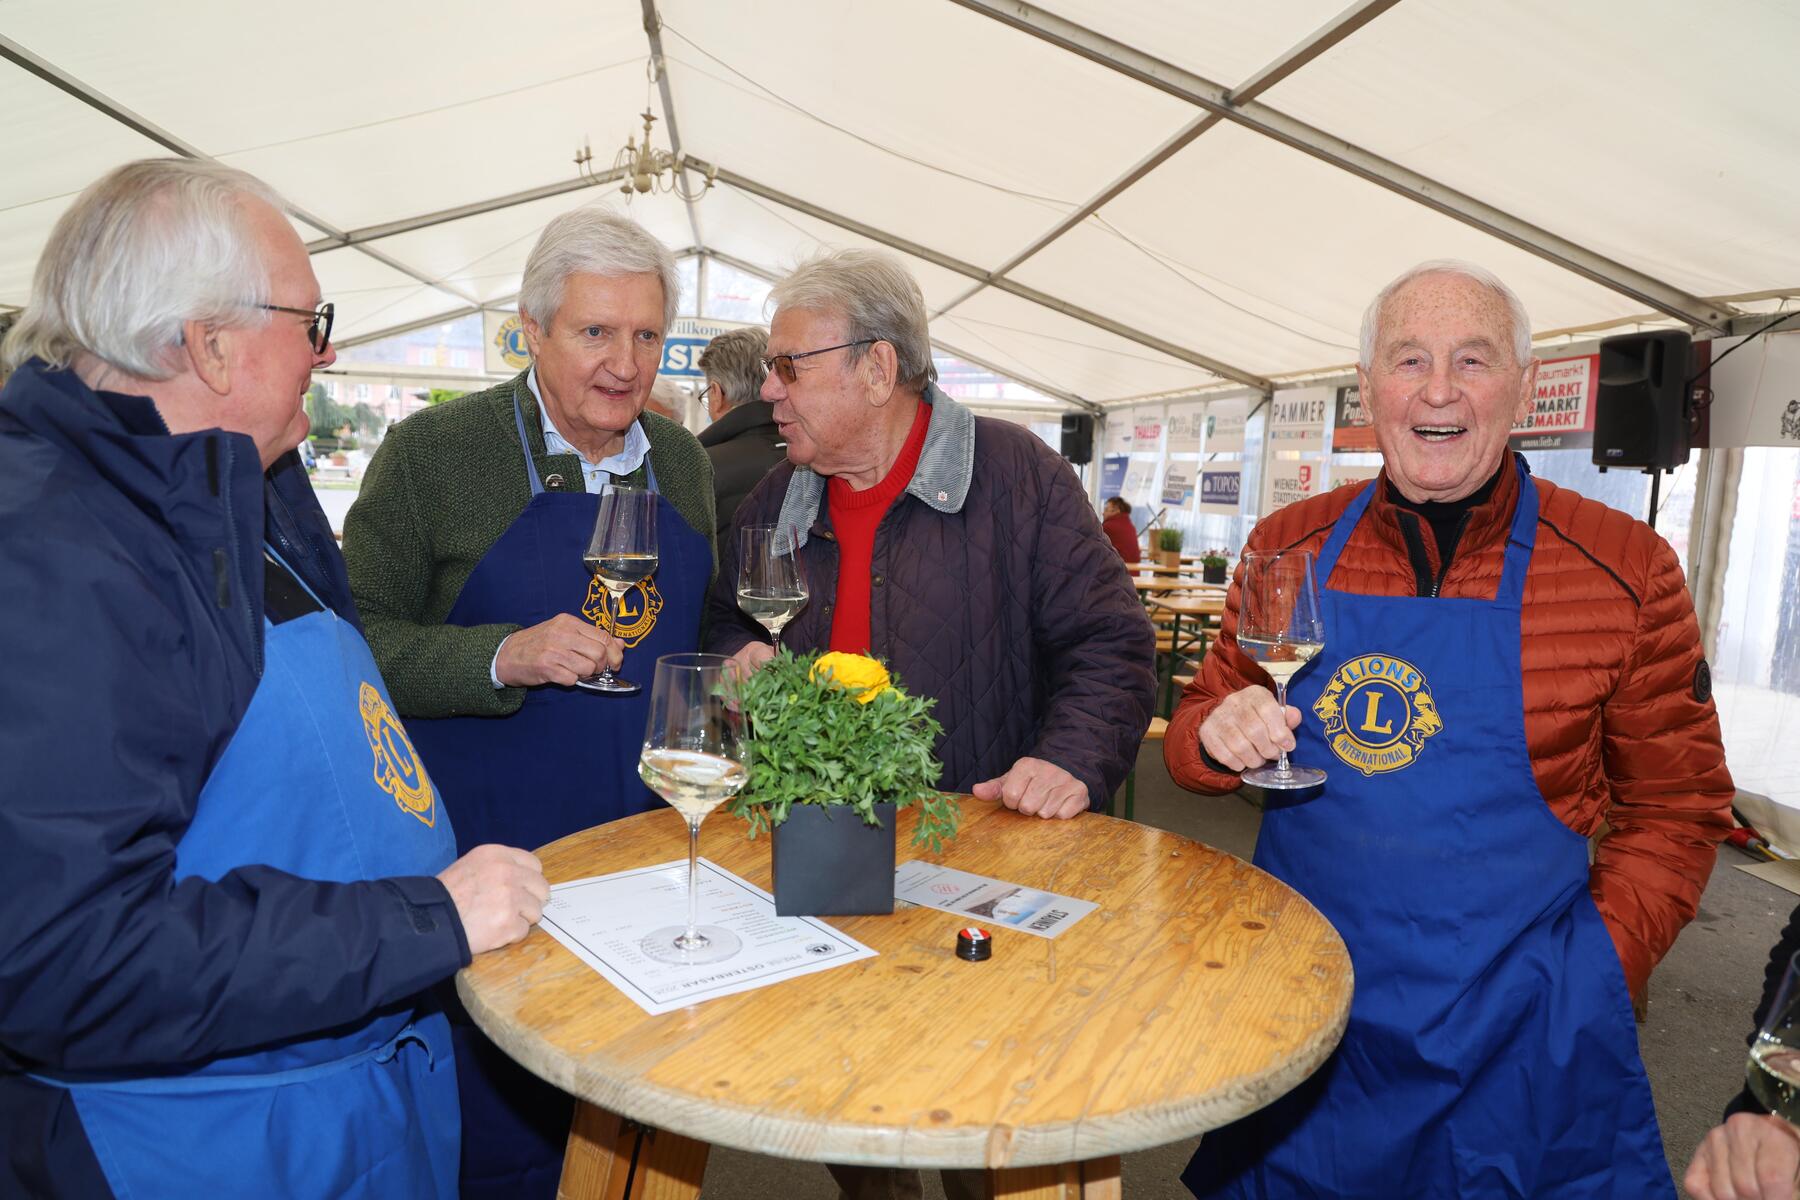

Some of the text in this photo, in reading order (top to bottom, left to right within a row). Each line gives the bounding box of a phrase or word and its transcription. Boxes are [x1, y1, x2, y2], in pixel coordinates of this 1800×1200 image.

[1273, 400, 1326, 422] PAMMER
[1212, 475, 1240, 493] TOPOS
[1273, 478, 1300, 491] WIENER
[1345, 657, 1418, 689] LIONS
[1360, 690, 1394, 735] L
[1337, 738, 1408, 766] INTERNATIONAL
